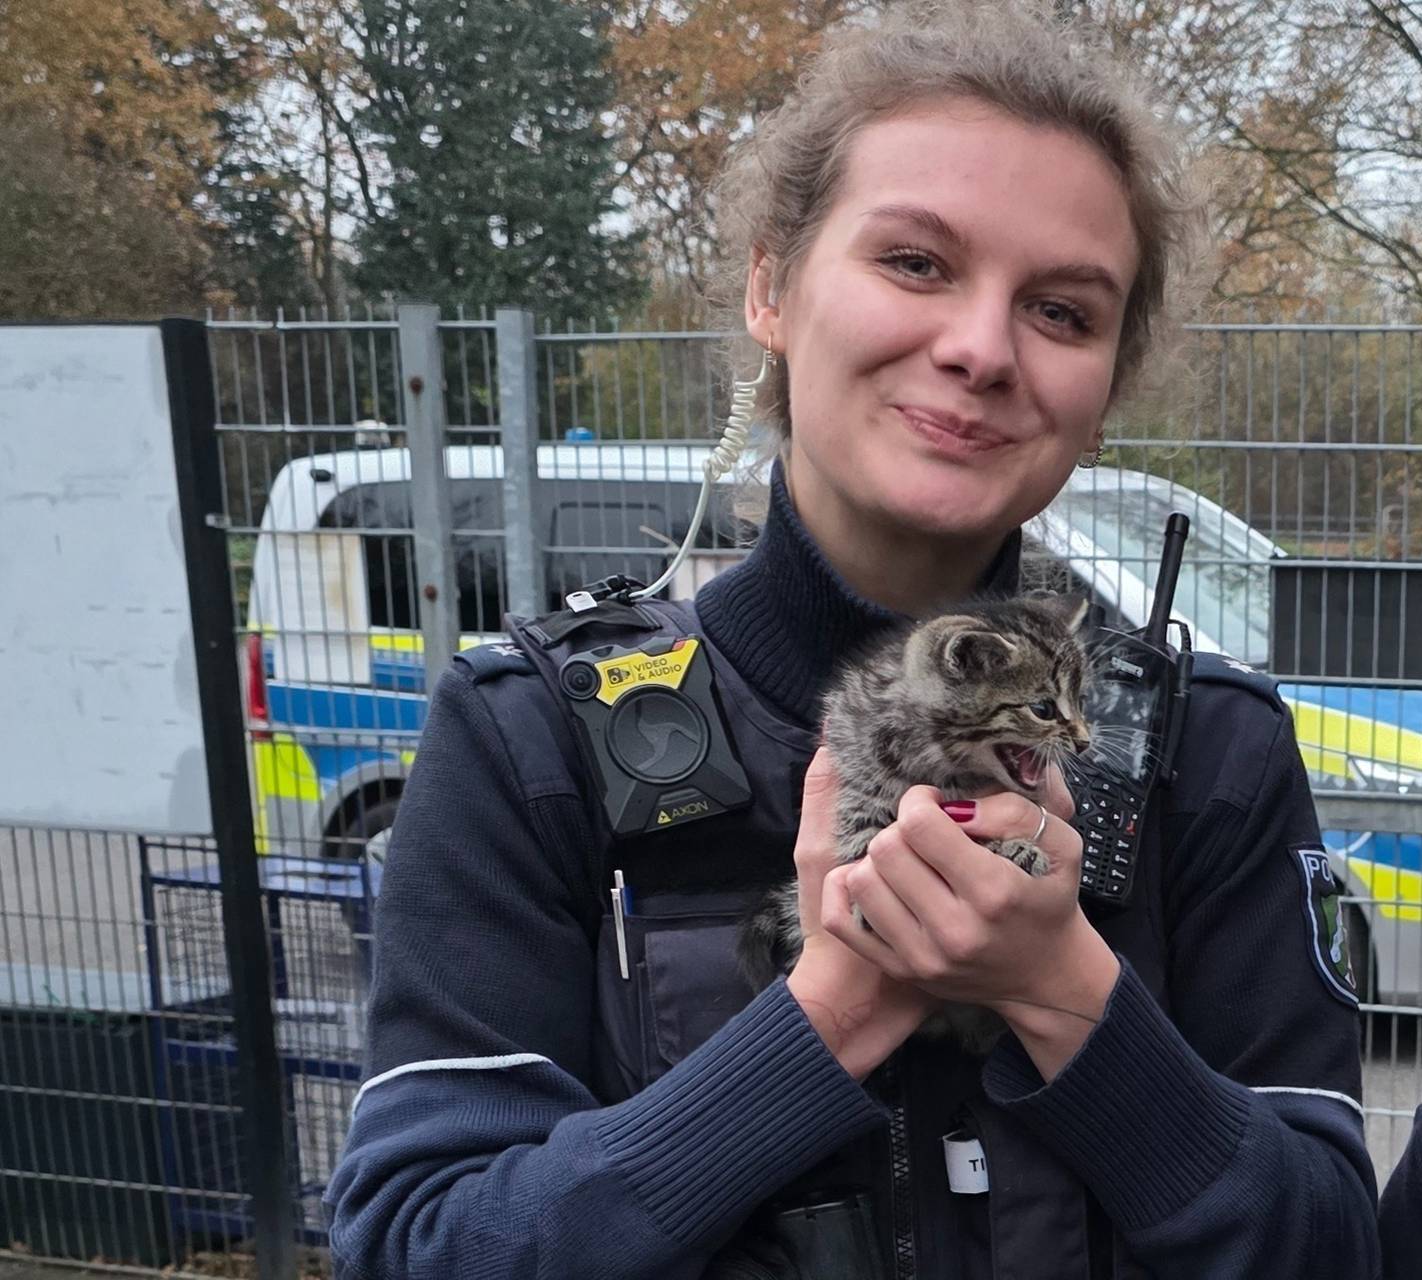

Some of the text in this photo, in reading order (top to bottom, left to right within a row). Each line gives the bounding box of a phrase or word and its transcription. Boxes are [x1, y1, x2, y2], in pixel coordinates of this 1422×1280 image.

[633, 658, 668, 673] VIDEO
[637, 664, 682, 681] & AUDIO
[671, 801, 709, 820] AXON
